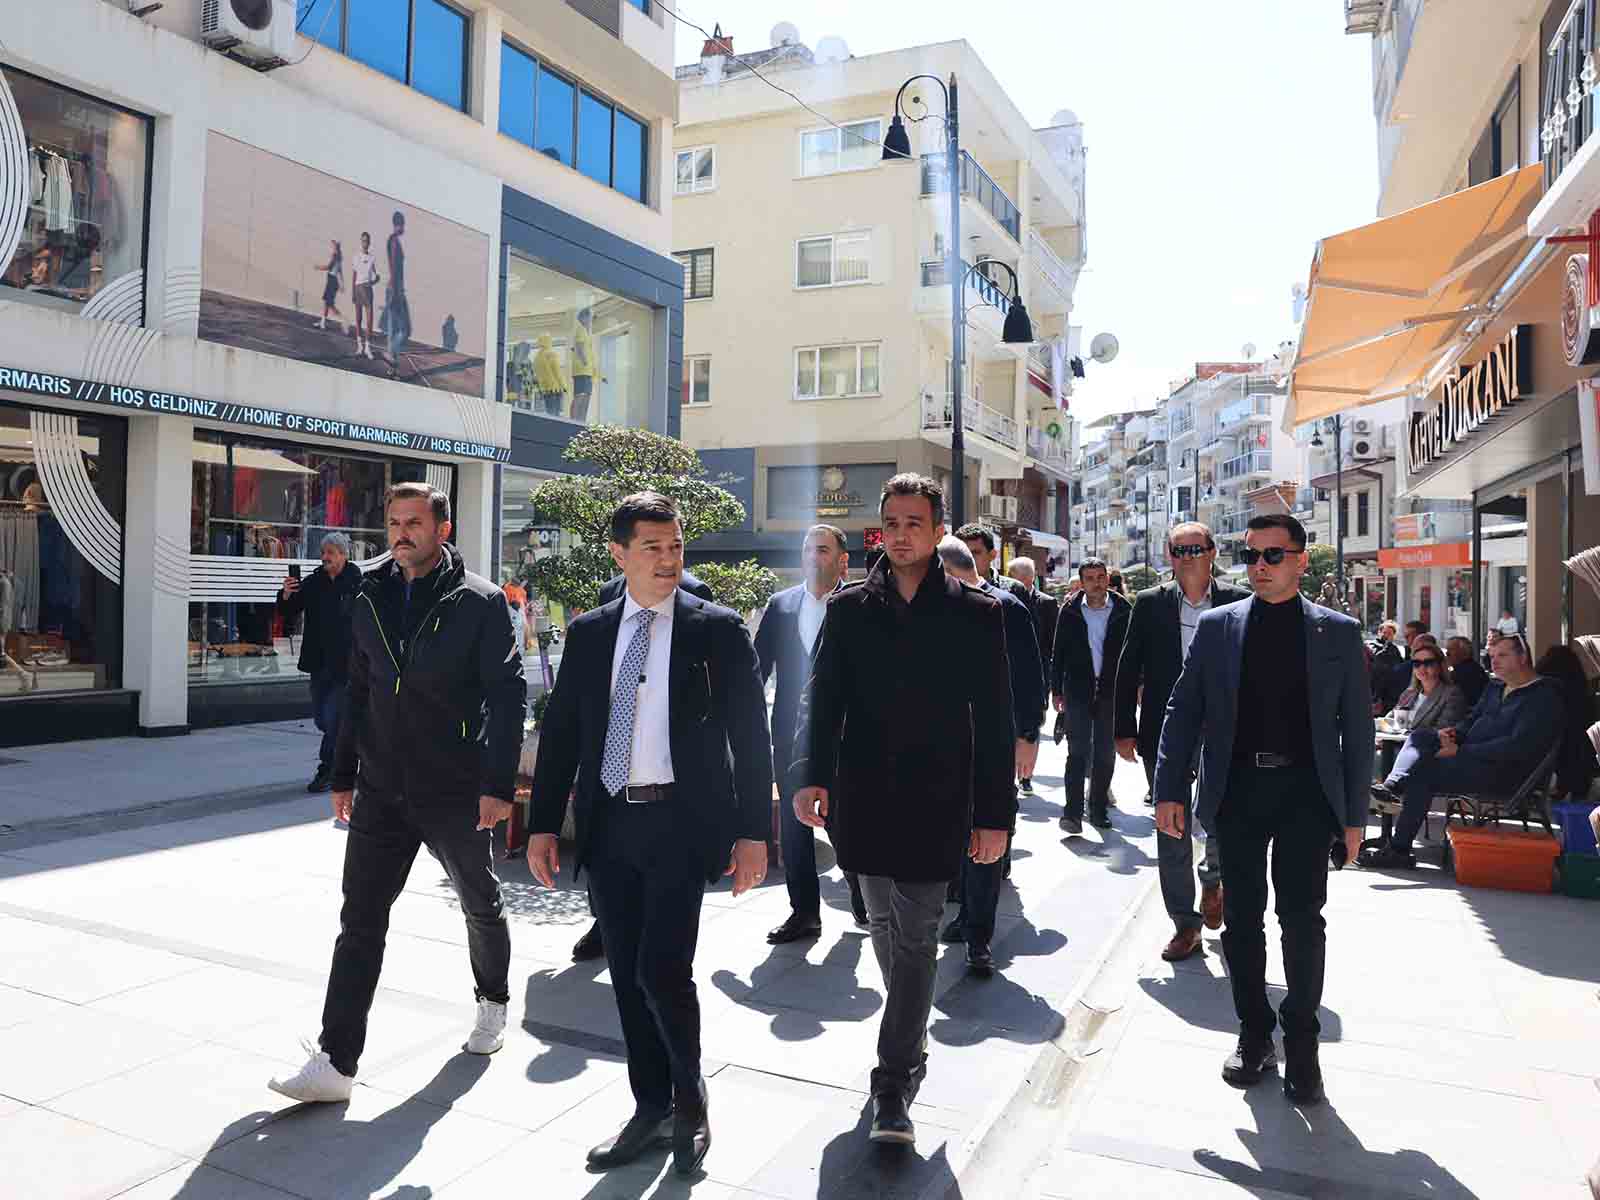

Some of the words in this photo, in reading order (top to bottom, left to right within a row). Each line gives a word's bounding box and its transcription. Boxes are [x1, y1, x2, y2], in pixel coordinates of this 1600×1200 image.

[110, 387, 144, 407] HOŞ
[286, 415, 303, 429] OF
[305, 418, 346, 436] SPORT
[431, 438, 451, 453] HOŞ
